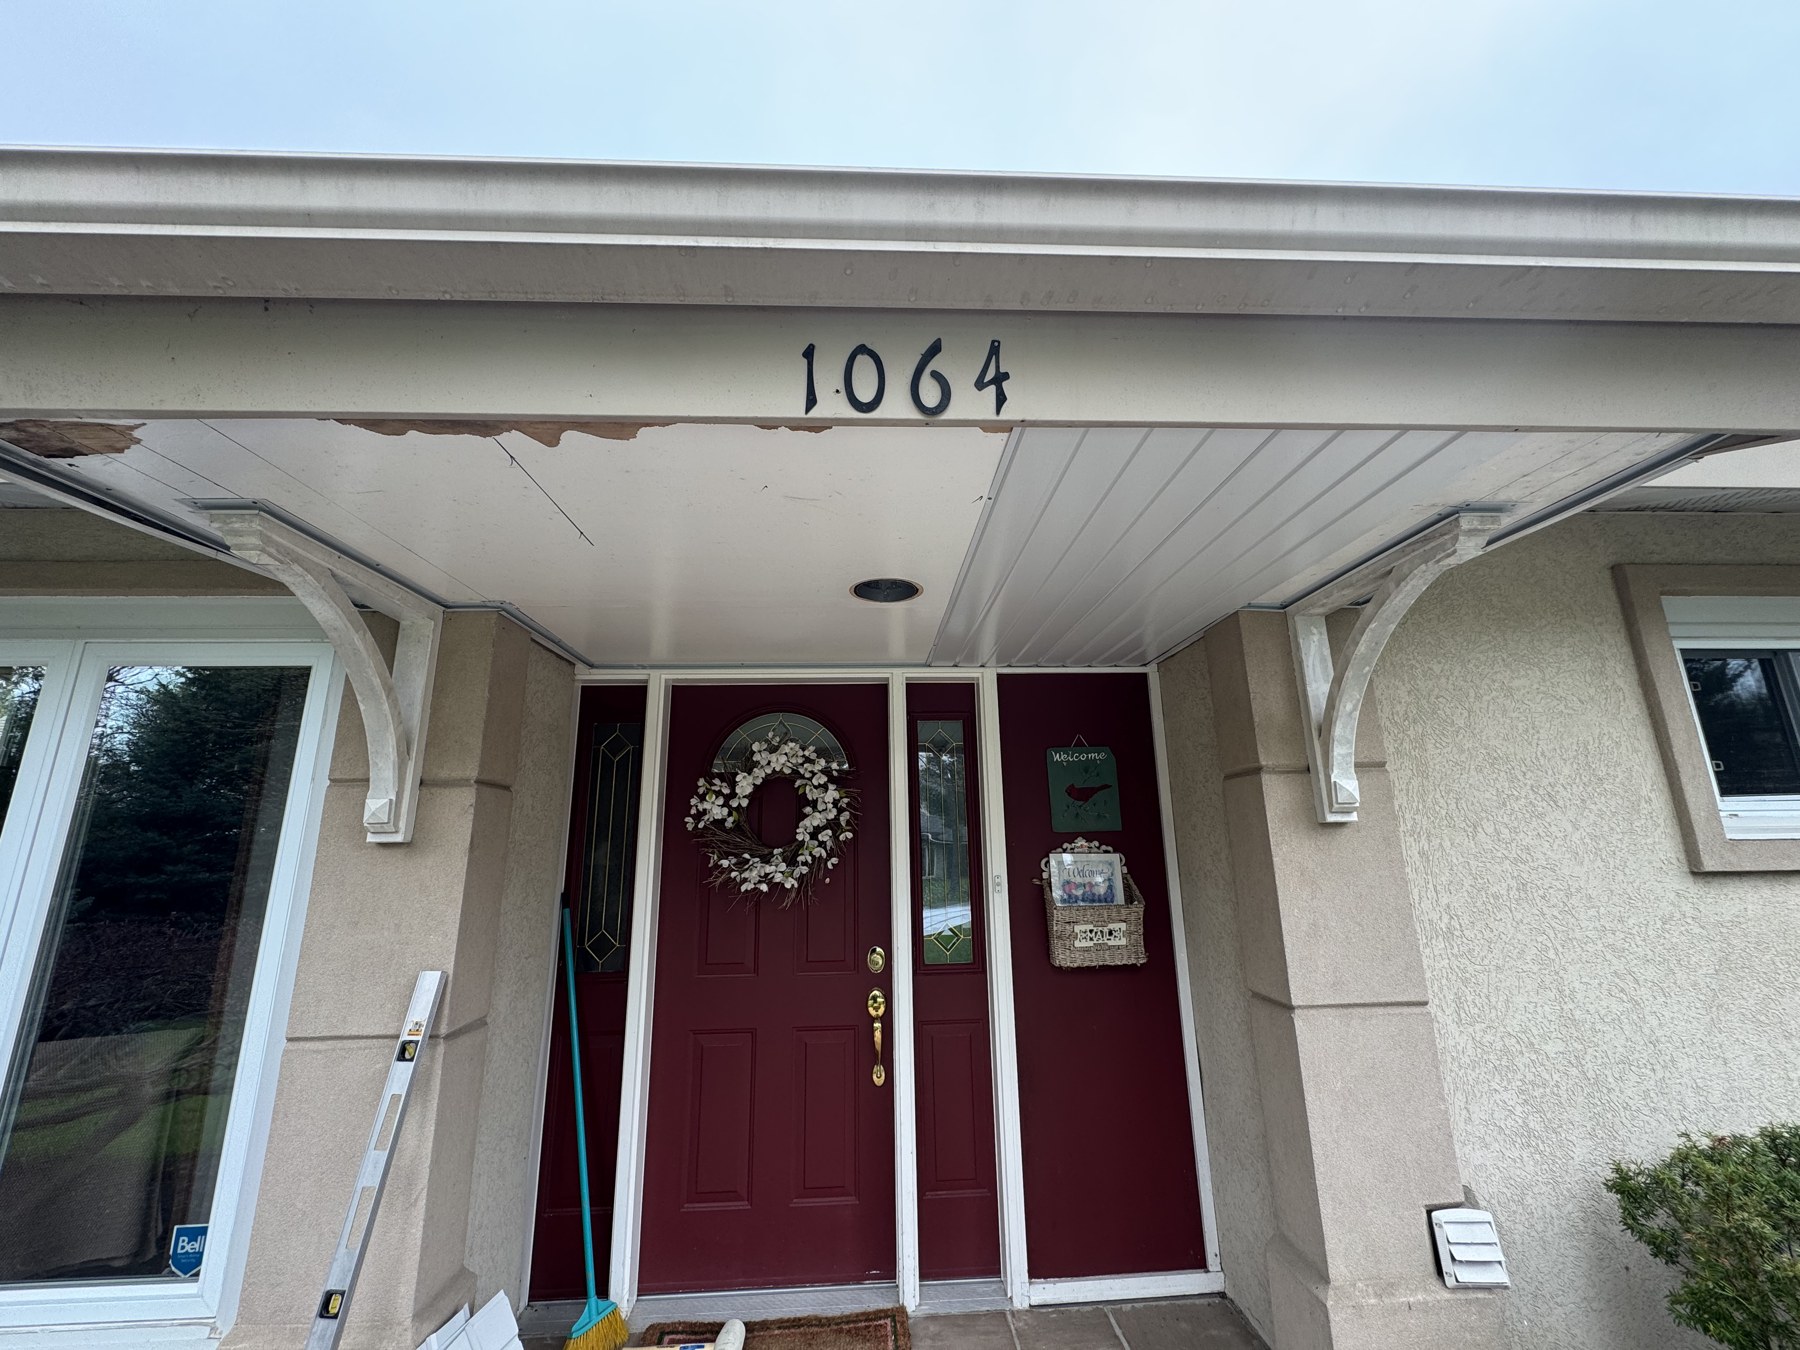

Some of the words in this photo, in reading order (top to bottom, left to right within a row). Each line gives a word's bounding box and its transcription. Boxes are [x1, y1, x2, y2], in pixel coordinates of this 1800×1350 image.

[802, 337, 1010, 415] 1064
[1051, 750, 1107, 762] Welcome
[177, 1235, 205, 1254] Bell
